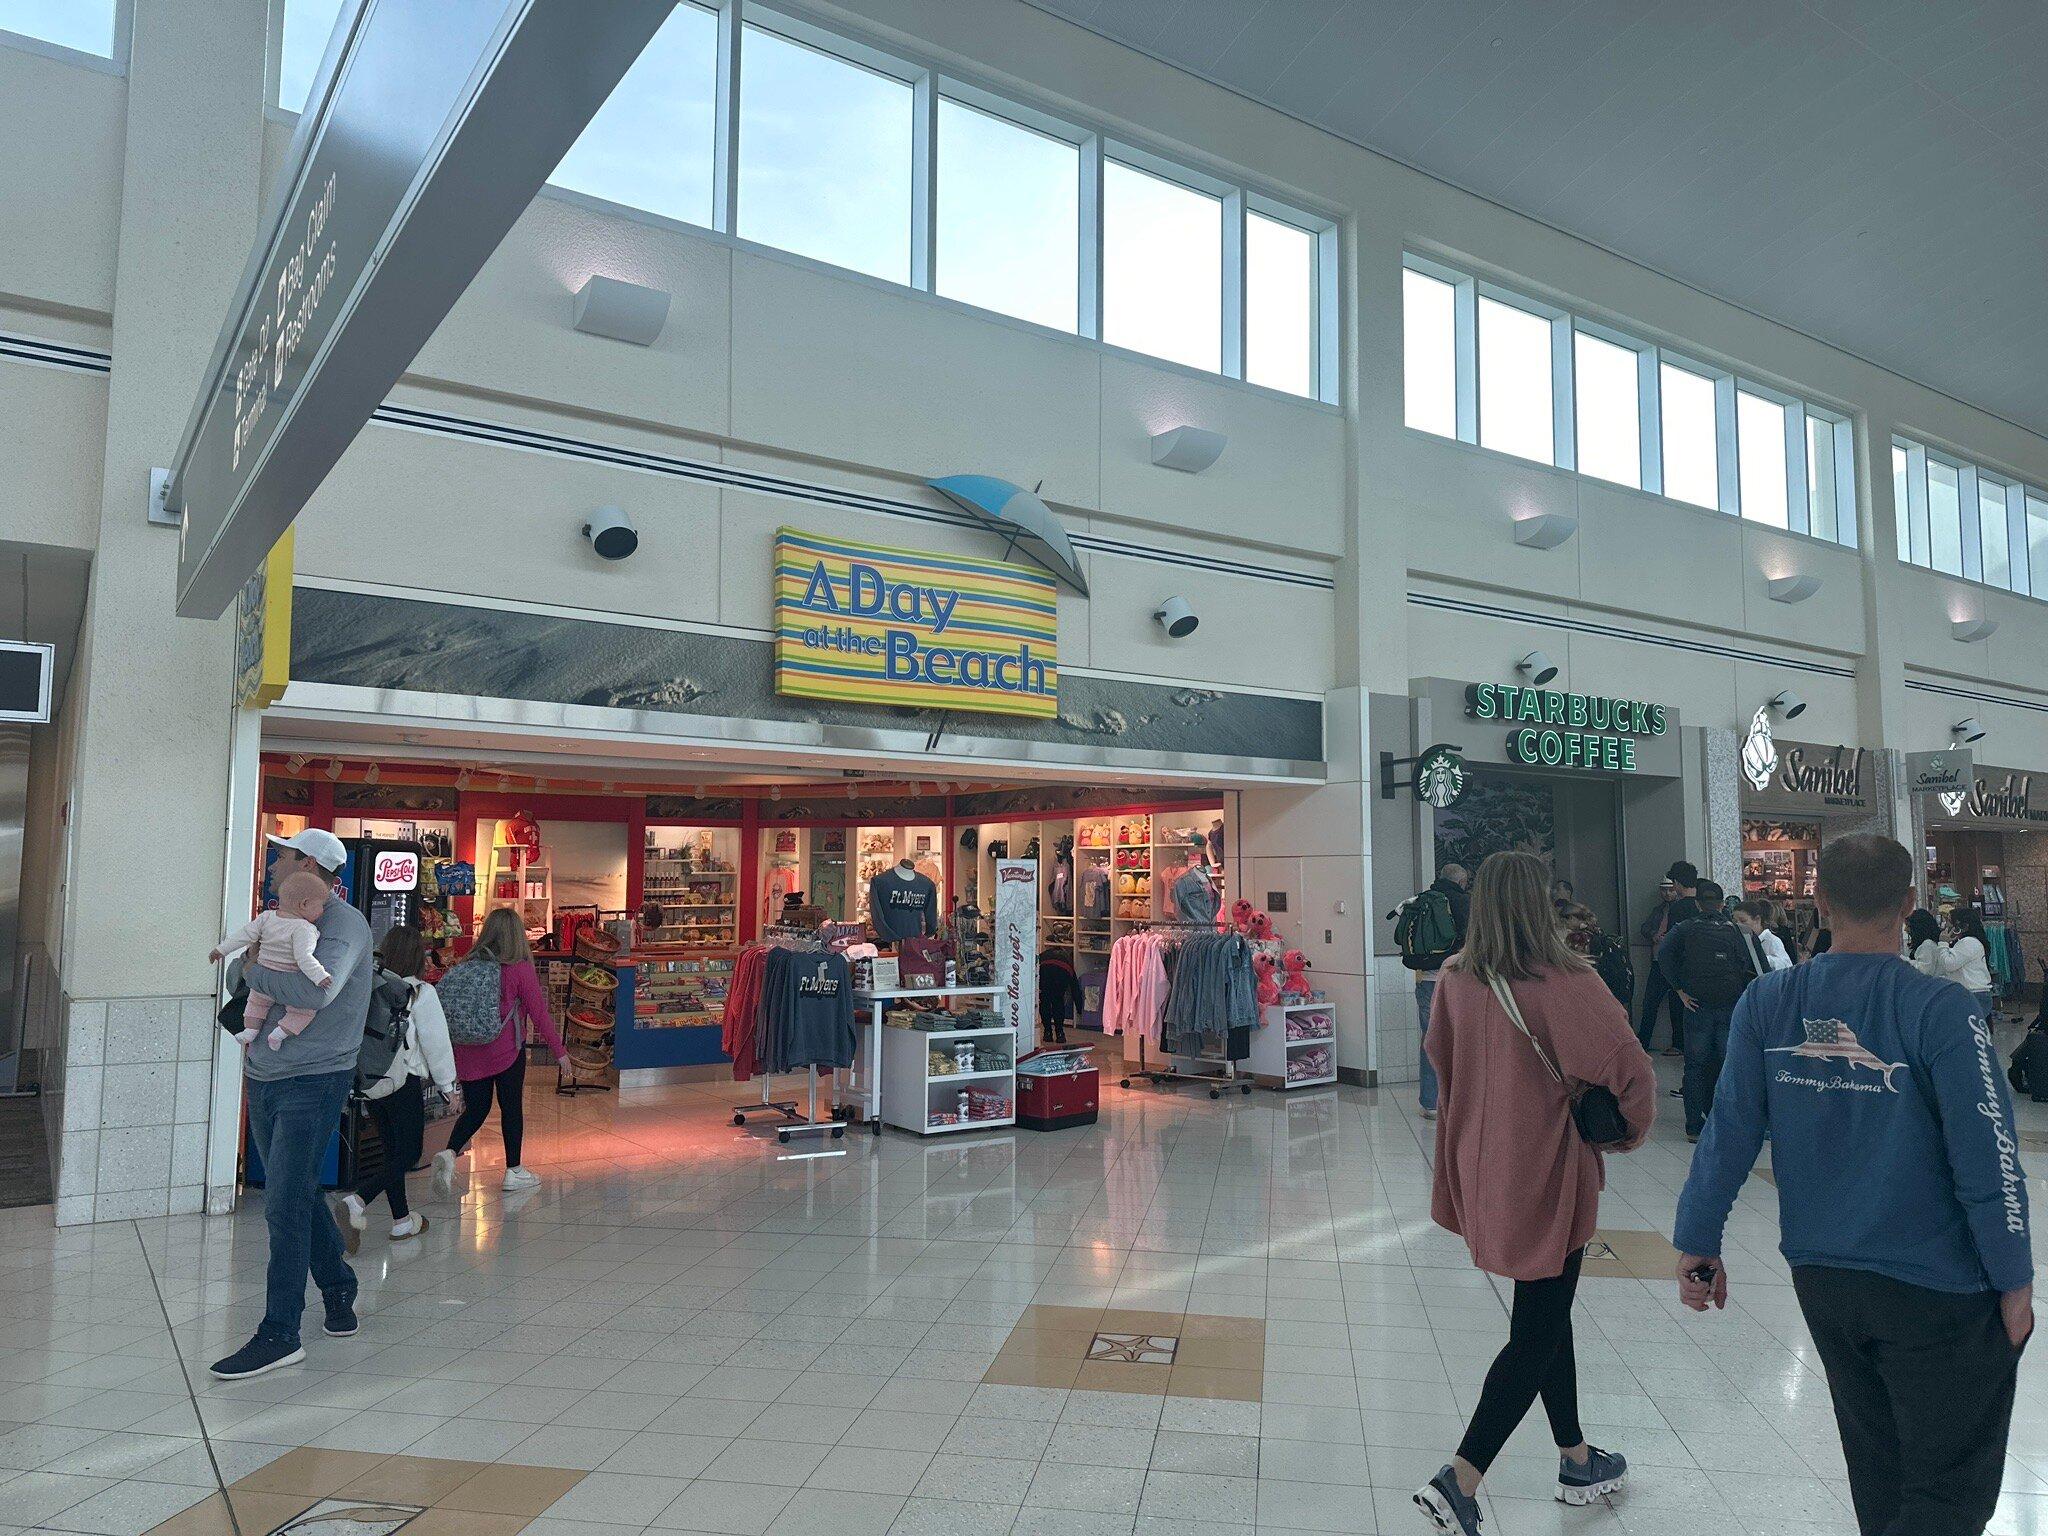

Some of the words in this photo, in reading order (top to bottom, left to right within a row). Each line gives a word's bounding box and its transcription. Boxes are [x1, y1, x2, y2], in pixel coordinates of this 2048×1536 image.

[287, 242, 304, 301] Bag
[307, 171, 336, 257] Claim
[285, 240, 337, 366] Restrooms
[802, 560, 840, 612] A
[850, 563, 960, 633] Day
[803, 625, 831, 648] at
[835, 627, 880, 656] the
[885, 629, 1046, 694] Beach
[1474, 682, 1667, 736] STARBUCKS
[1516, 728, 1637, 771] COFFEE
[1782, 745, 1865, 796] Sanibel
[1916, 769, 1960, 785] Sanibel
[1968, 774, 2031, 818] Sanibel
[902, 890, 926, 906] Myers
[810, 976, 838, 993] Myers
[1007, 963, 1020, 1000] there
[1011, 1003, 1019, 1028] we
[1775, 1069, 1827, 1092] Tommy
[1967, 1014, 2003, 1122] Tommy
[1994, 1120, 2025, 1234] Bahama
